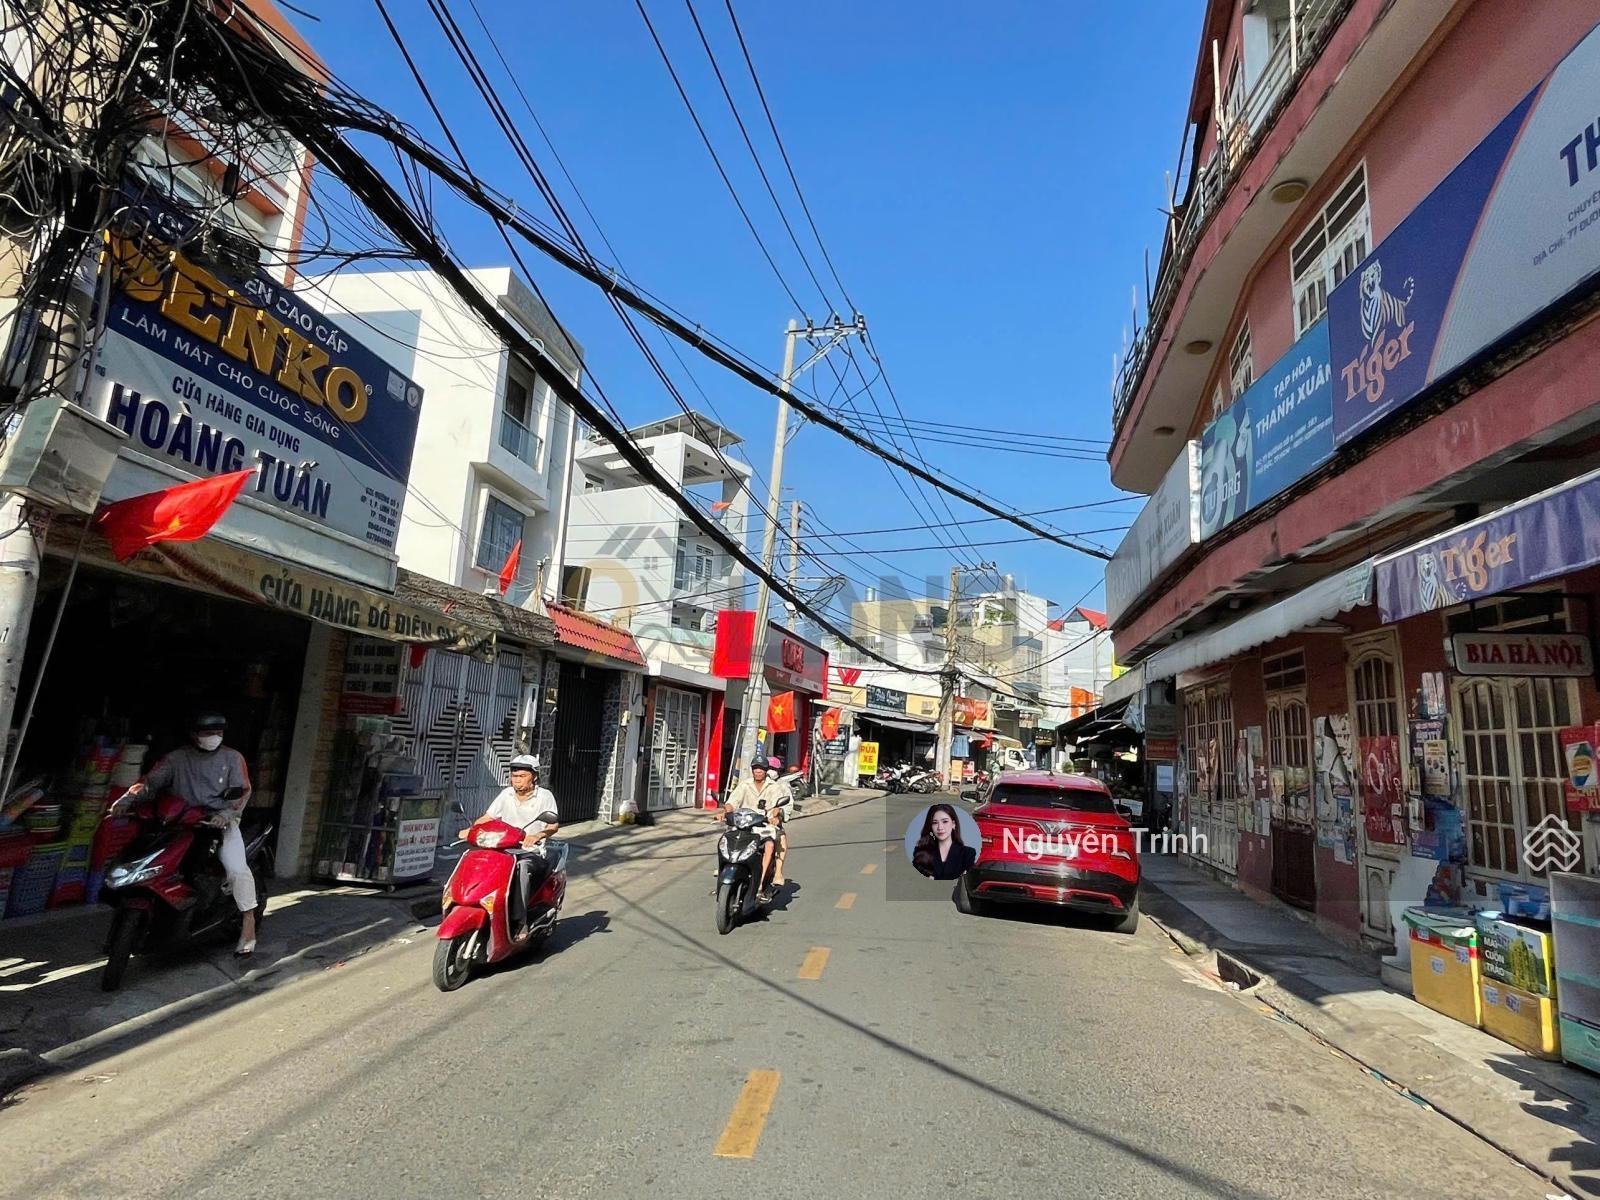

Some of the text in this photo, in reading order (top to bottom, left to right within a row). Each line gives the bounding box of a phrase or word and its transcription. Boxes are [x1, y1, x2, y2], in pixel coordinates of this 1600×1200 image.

[122, 307, 167, 342] LÀM
[217, 362, 253, 389] CHO
[276, 298, 313, 331] CAO
[315, 325, 349, 354] CẤP
[1341, 320, 1415, 403] Tiger
[172, 376, 300, 454] CỬA HÀNG GIA DỤNG
[1255, 392, 1295, 438] THANH
[105, 381, 332, 519] HOÀNG TUẤN
[1203, 470, 1241, 513] TUORG
[1440, 530, 1517, 592] Tiger
[309, 586, 361, 628] HÀNG
[1464, 637, 1585, 668] BIA HÀ NỘI
[863, 755, 874, 764] XE
